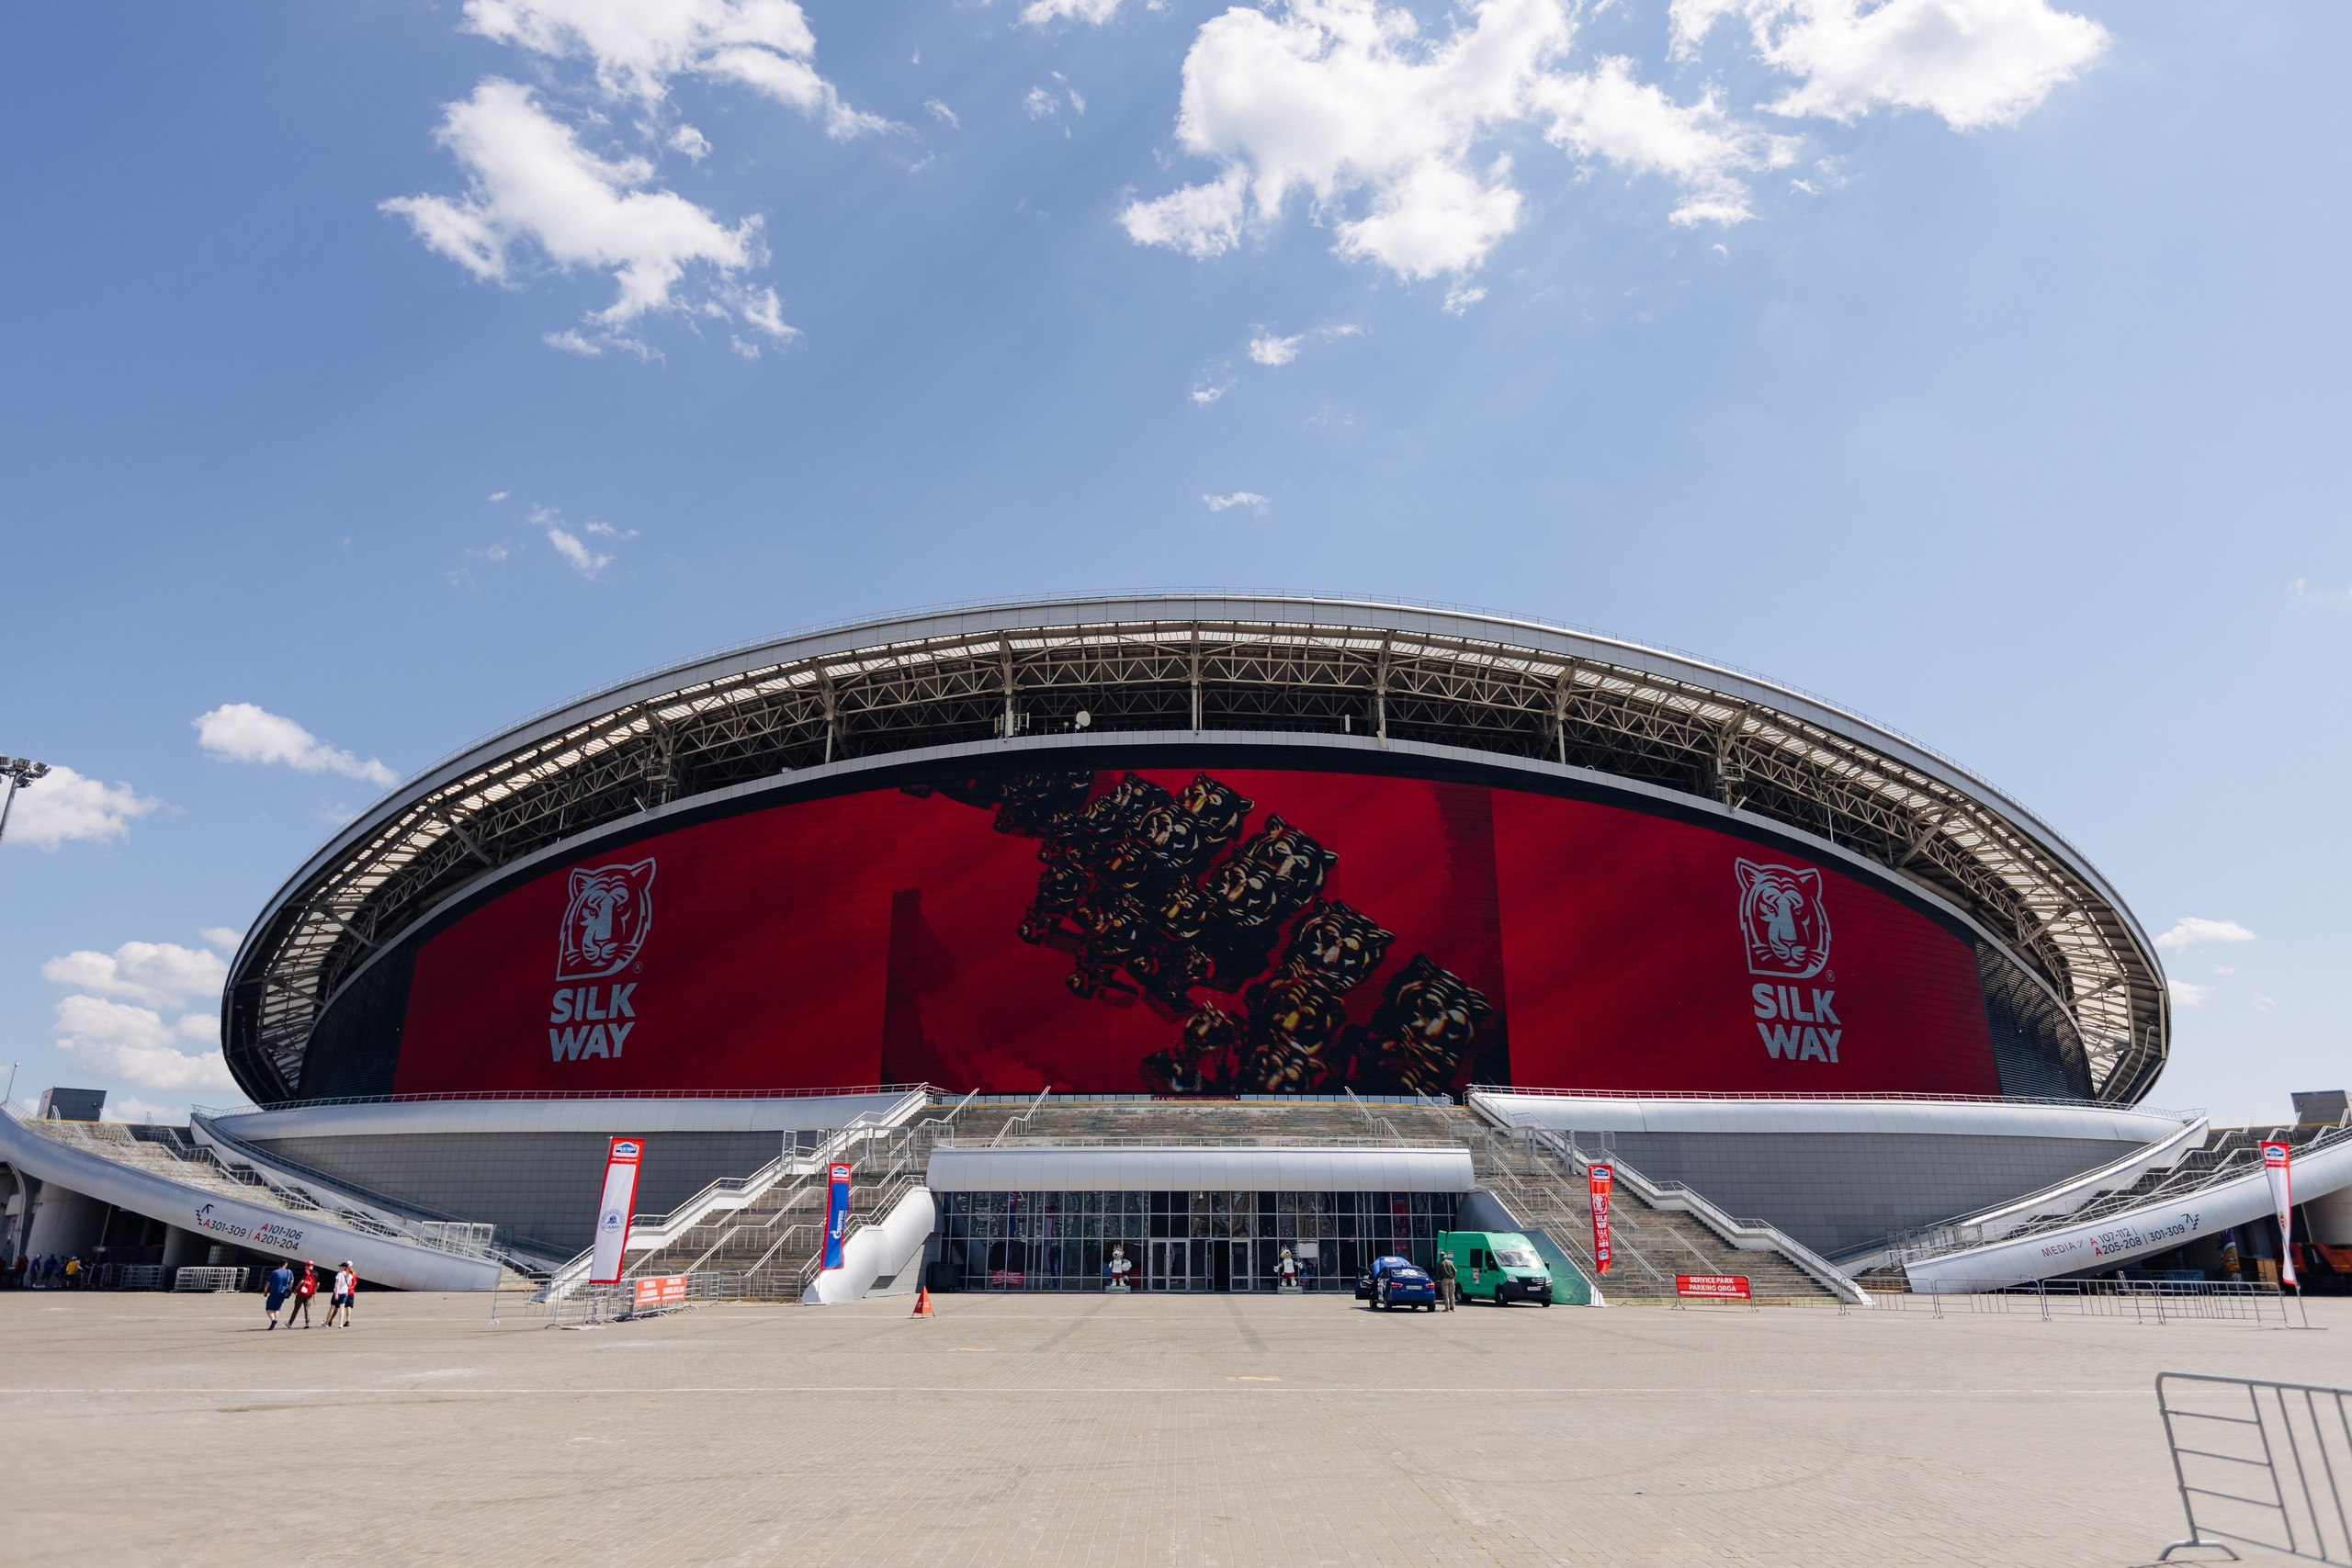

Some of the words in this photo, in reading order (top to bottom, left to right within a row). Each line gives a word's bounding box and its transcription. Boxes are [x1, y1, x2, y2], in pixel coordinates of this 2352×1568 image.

[549, 982, 639, 1024] SILK
[1752, 983, 1841, 1025] SILK
[548, 1021, 636, 1063] WAY
[1756, 1022, 1842, 1064] WAY
[2041, 1241, 2077, 1258] MEDIA
[2150, 1224, 2186, 1242] 301-309
